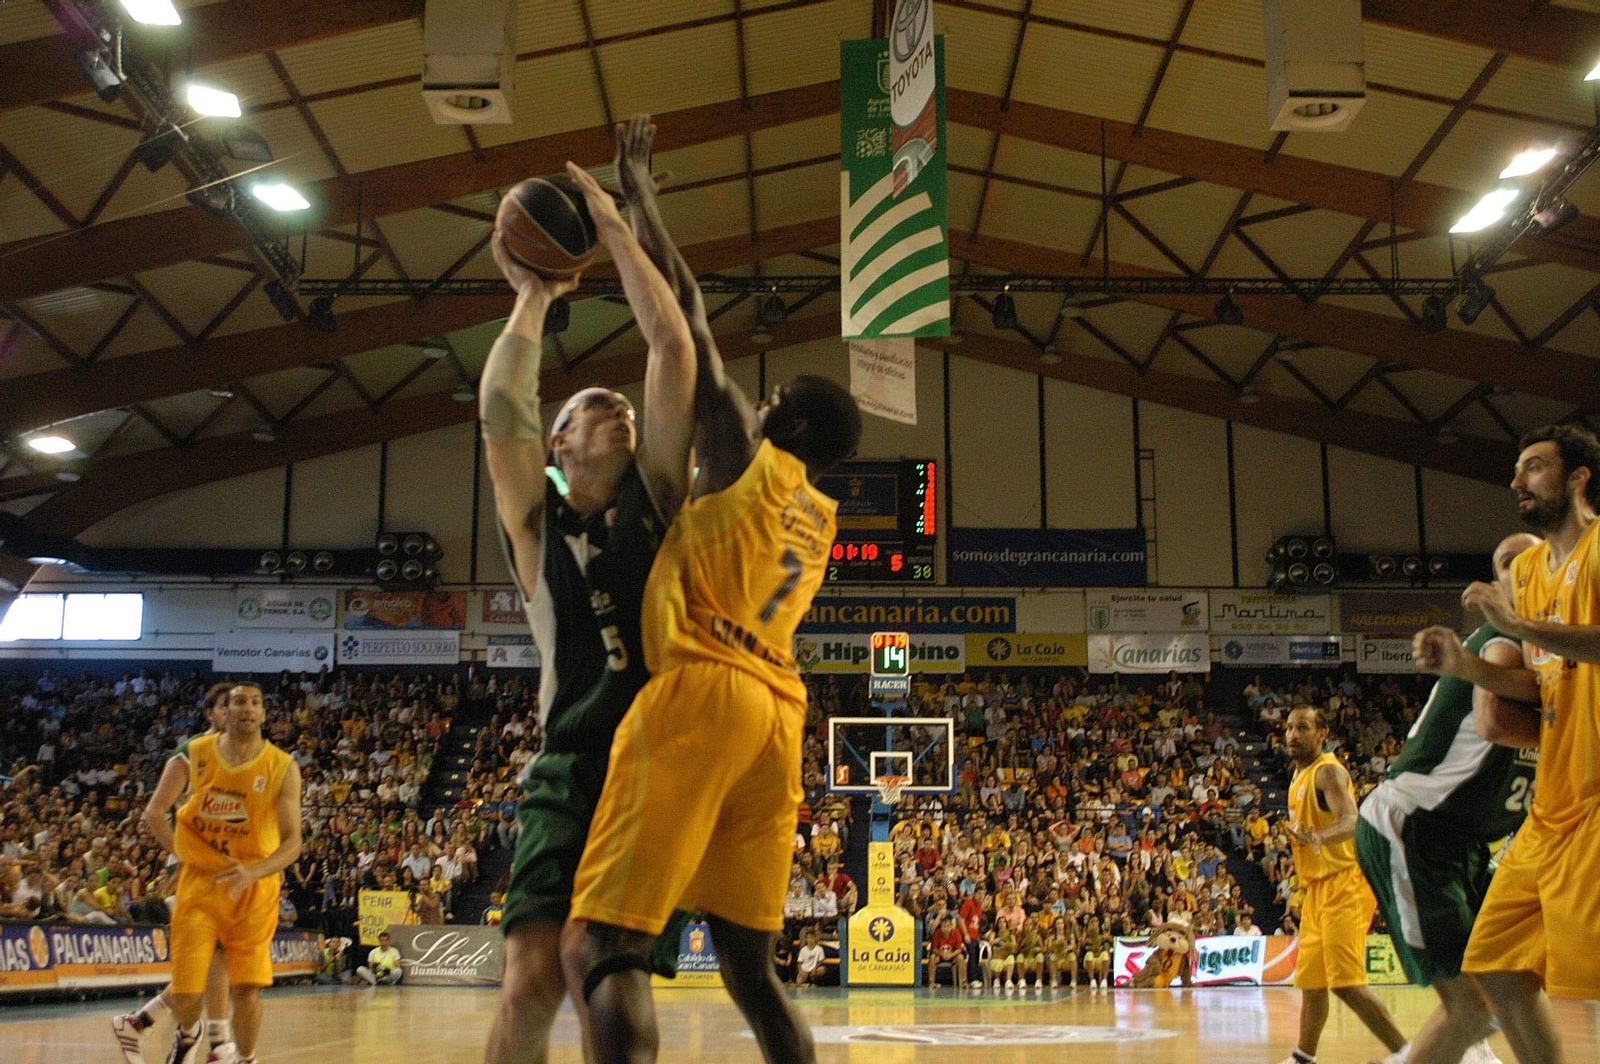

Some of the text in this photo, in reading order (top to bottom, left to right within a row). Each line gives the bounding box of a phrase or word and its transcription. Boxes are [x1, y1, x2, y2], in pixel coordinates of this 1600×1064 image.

[891, 41, 933, 103] TOYOTA
[953, 548, 1144, 566] somosdegrancanaria.com
[758, 548, 803, 625] 7
[217, 647, 311, 657] Vemotor Canarias
[361, 641, 457, 655] PERPETUO SOCORRO
[601, 624, 628, 671] 5
[883, 646, 905, 669] 14
[1016, 643, 1065, 657] La Caja
[1113, 642, 1201, 667] Canarias
[873, 680, 908, 689] RACER
[202, 792, 242, 814] Kalise
[208, 822, 221, 833] La
[53, 932, 155, 964] PALCANARIAS
[400, 930, 493, 968] Lledó
[852, 948, 911, 963] La Caja
[410, 964, 478, 977] iluminación
